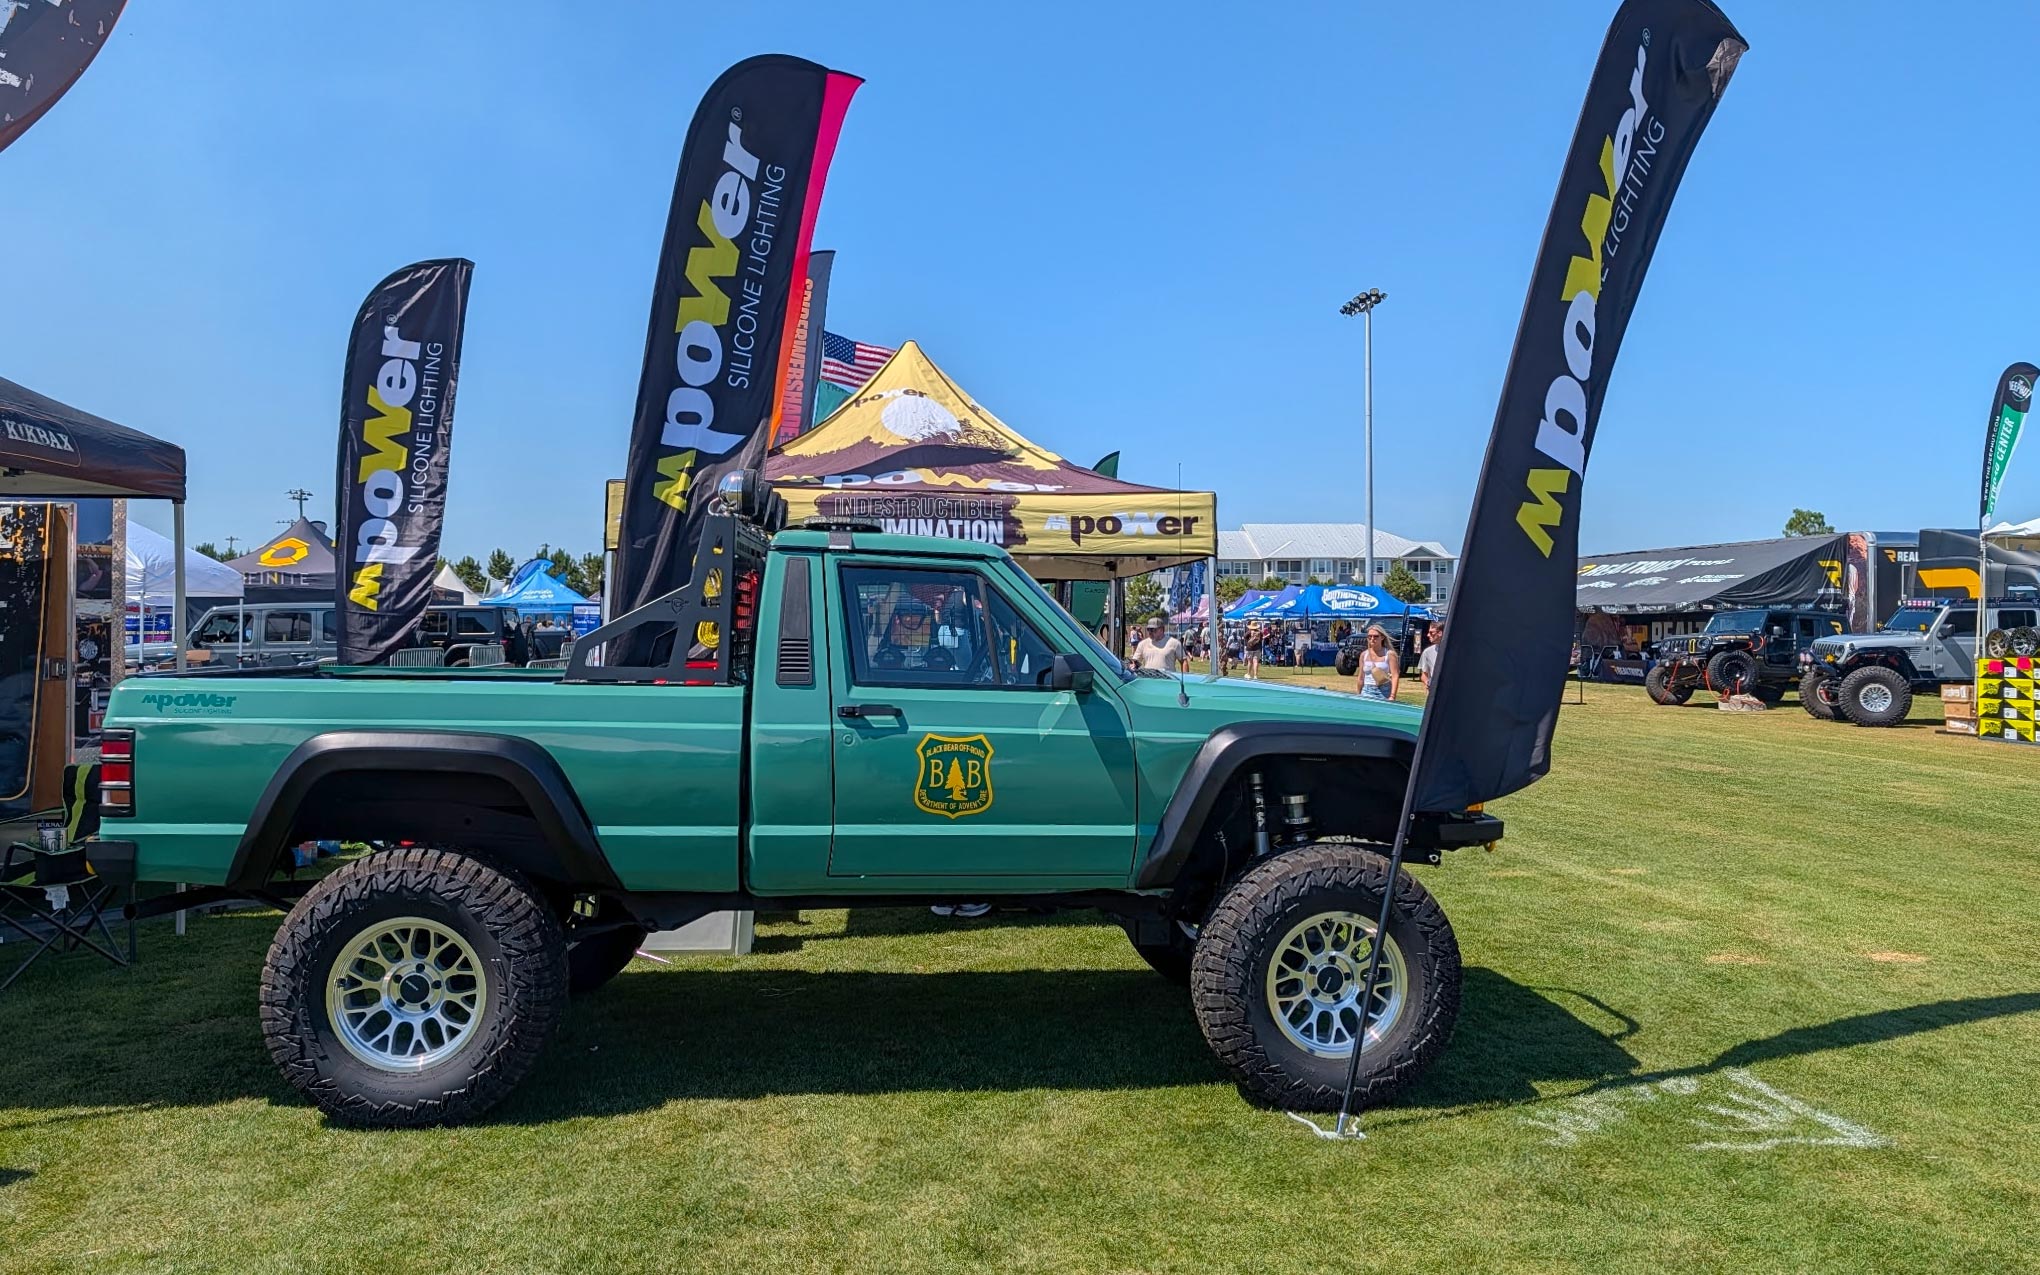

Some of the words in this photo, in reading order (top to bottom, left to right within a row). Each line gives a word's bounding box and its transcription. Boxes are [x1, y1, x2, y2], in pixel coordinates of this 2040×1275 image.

[1604, 115, 1665, 258] LIGHTING
[728, 279, 763, 389] SILICONE
[747, 164, 787, 277] LIGHTING
[419, 341, 444, 428] LIGHTING
[1996, 416, 2015, 462] CENTER
[407, 429, 433, 514] SILICONE
[833, 496, 1004, 520] INDESTRUCTIBLE
[926, 744, 944, 758] BLACK
[944, 743, 960, 752] BEAR
[929, 759, 944, 788] B
[966, 759, 982, 788] B
[949, 802, 957, 810] OF
